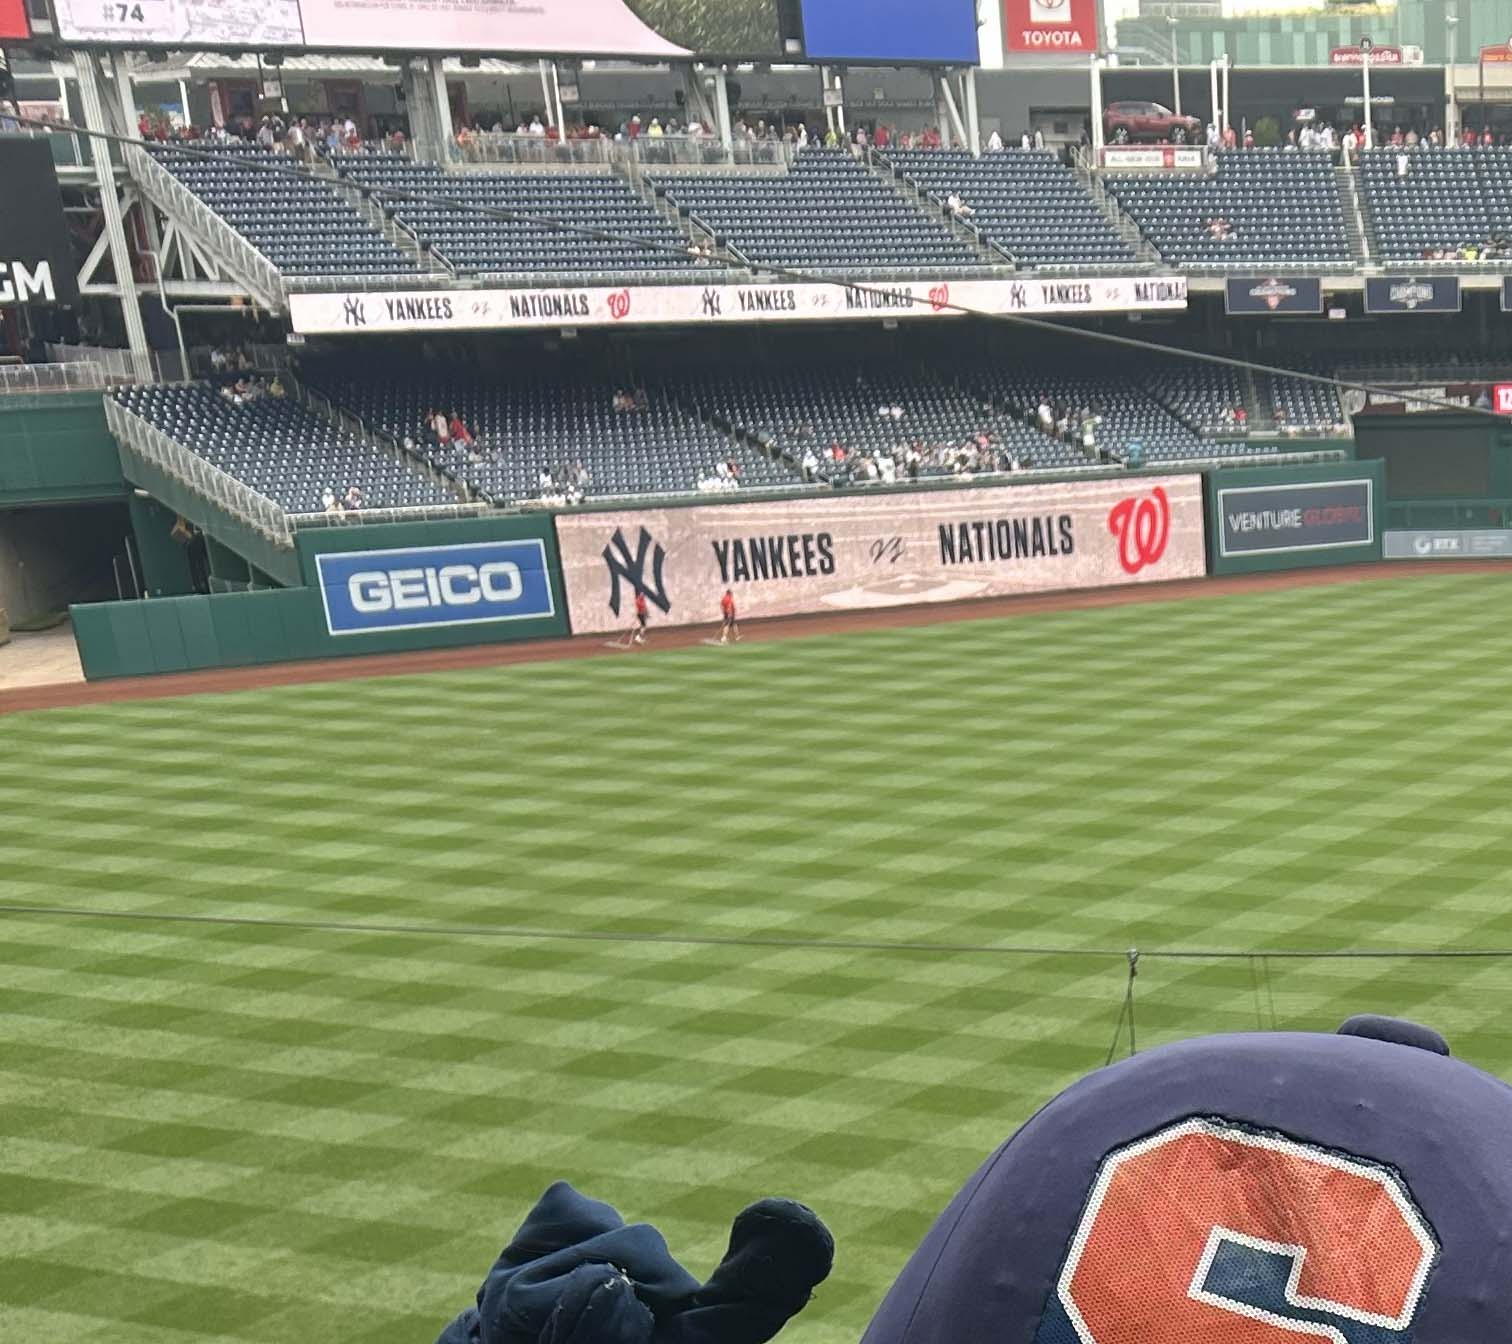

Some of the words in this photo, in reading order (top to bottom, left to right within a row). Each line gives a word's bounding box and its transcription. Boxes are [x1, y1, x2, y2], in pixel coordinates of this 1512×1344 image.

[1022, 30, 1083, 46] TOYOTA
[384, 298, 454, 320] YANKEES
[510, 294, 591, 319] NATIONALS
[738, 289, 797, 312] YANKEES
[845, 287, 915, 310] NATIONALS
[1041, 283, 1093, 304] YANKEES
[1228, 508, 1302, 532] VENTURE
[712, 532, 835, 583] YANKEES
[938, 514, 1073, 565] NATIONALS
[348, 561, 523, 613] GEICO
